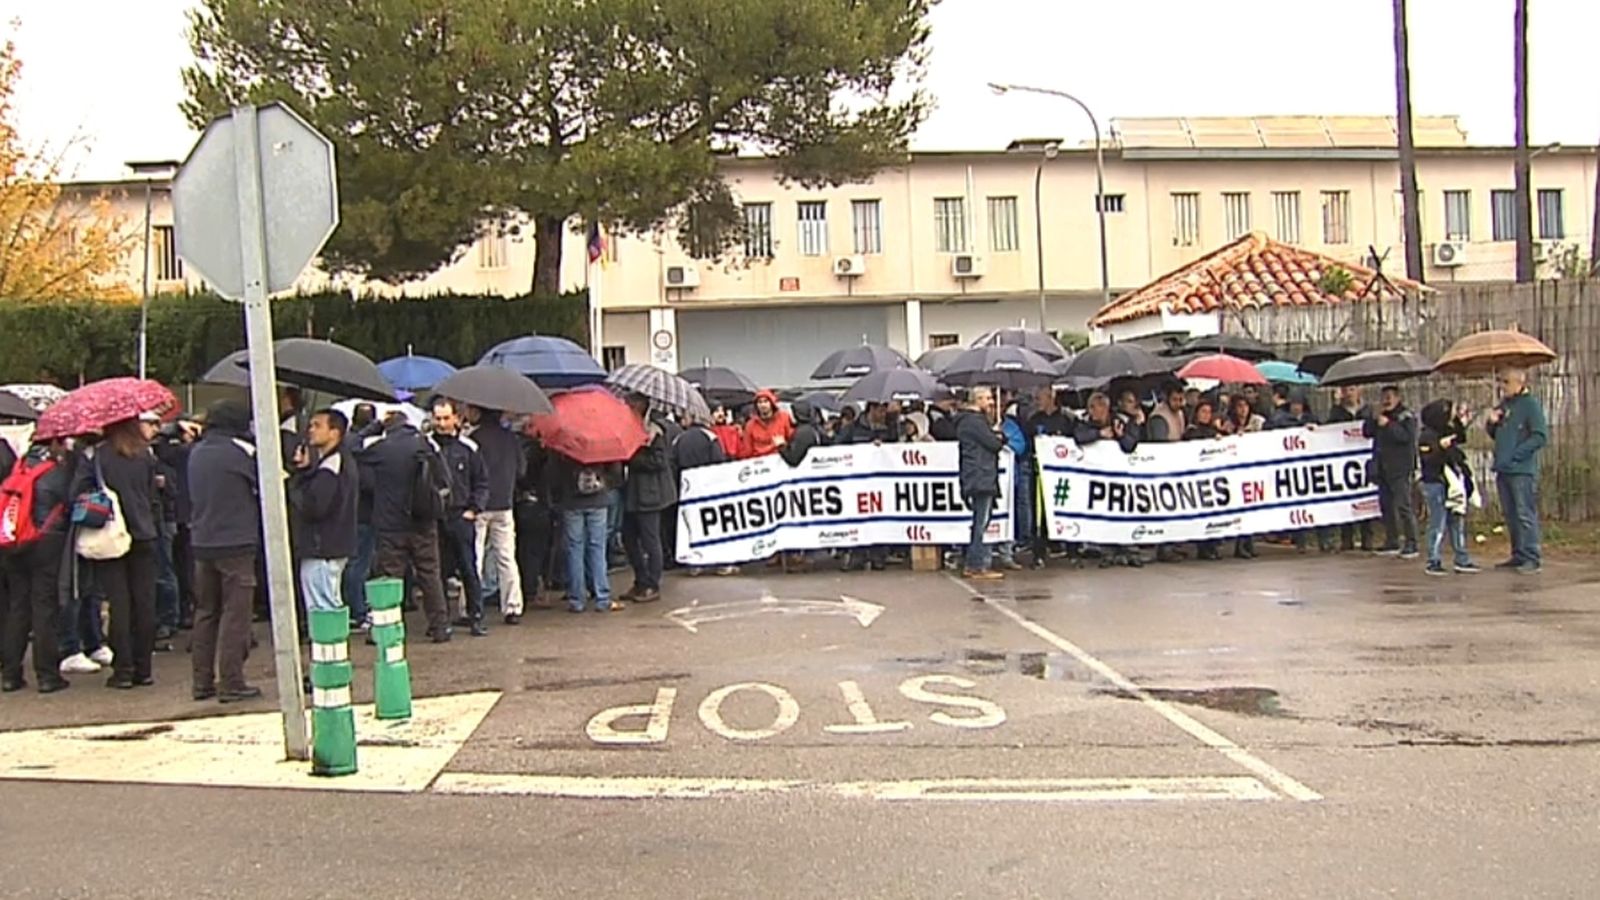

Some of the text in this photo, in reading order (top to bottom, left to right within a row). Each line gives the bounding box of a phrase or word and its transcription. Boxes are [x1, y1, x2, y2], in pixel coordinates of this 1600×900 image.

[700, 482, 1002, 536] PRISIONES EN HUEL
[1053, 477, 1070, 506] #
[1088, 477, 1230, 514] PRISIONES
[1242, 481, 1264, 503] EN
[586, 674, 1006, 744] STOP
